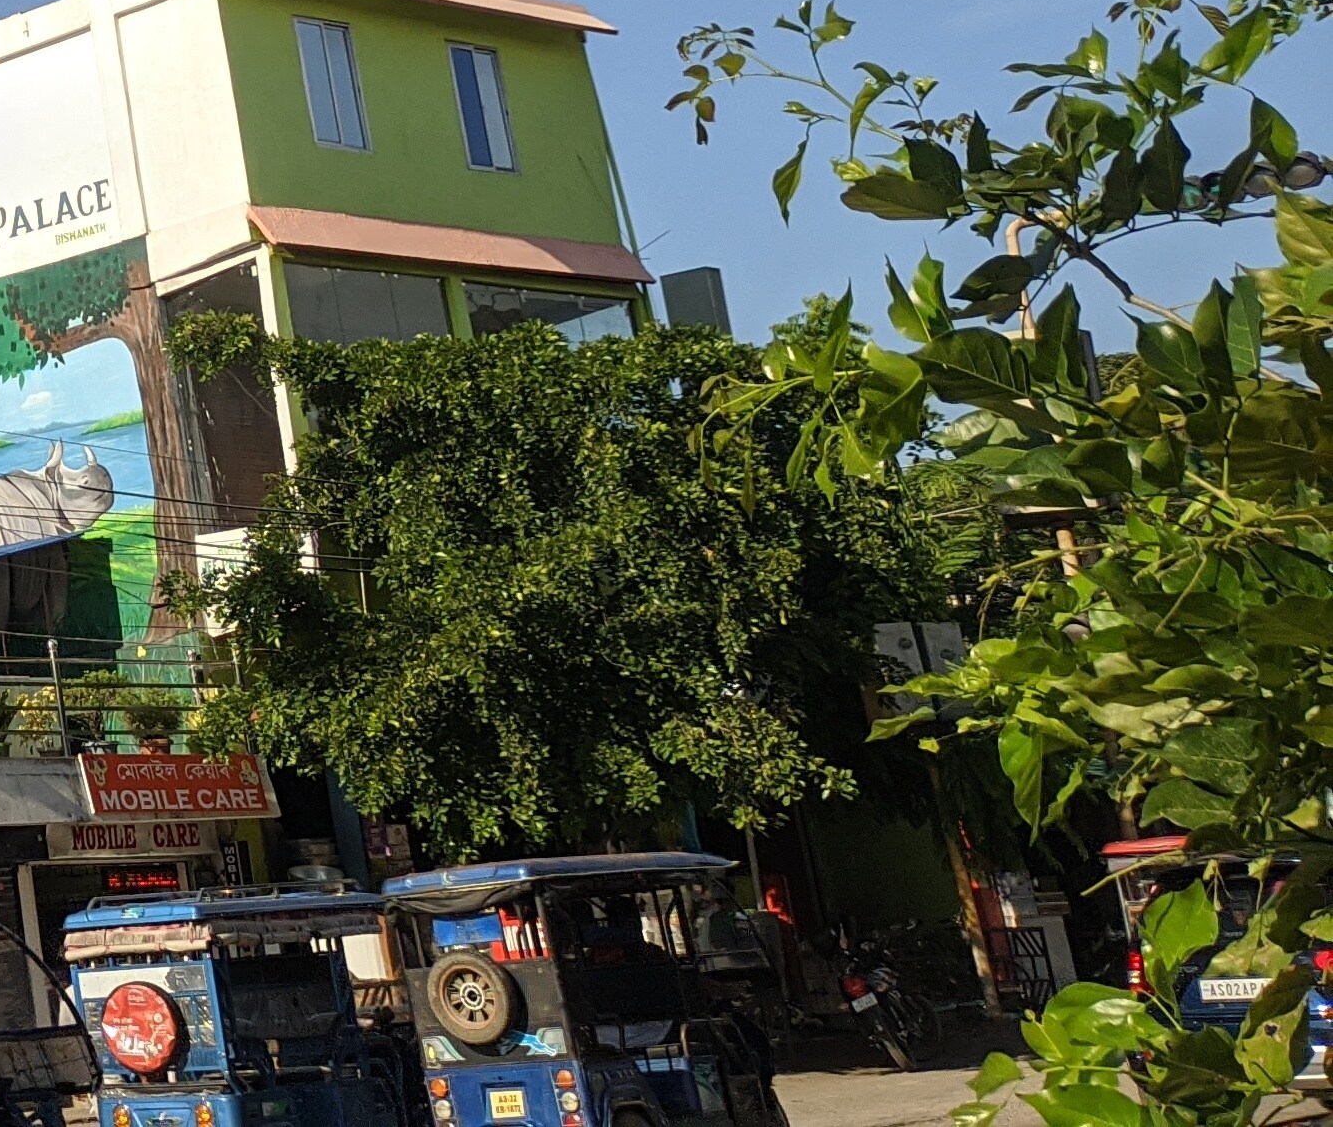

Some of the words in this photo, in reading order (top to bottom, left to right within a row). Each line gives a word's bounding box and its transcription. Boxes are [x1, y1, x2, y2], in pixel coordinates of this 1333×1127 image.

[117, 759, 179, 782] মোবাইল
[99, 789, 194, 811] MOBILE
[197, 788, 263, 810] CARE
[71, 824, 137, 850] MOBILE
[152, 823, 200, 848] CARE
[224, 846, 238, 886] MOBI
